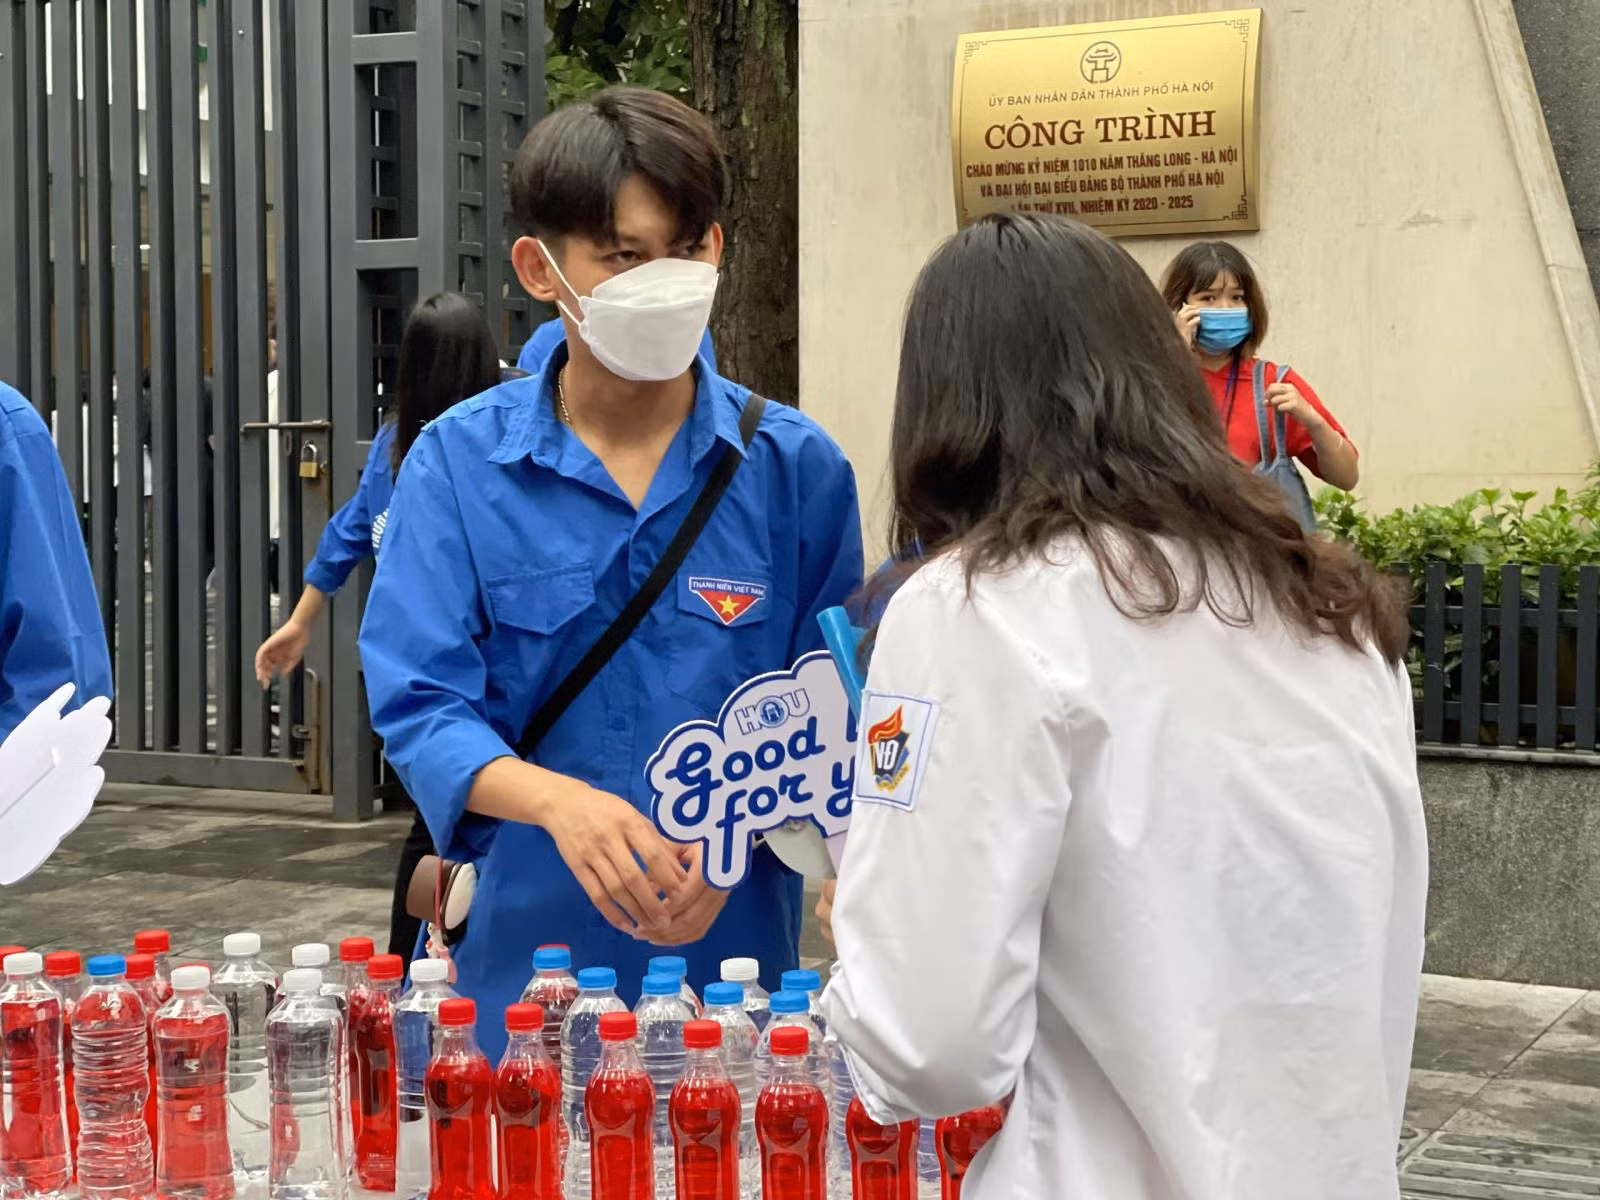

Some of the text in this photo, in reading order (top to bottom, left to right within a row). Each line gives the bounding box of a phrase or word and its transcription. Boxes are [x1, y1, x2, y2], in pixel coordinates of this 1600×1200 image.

[1008, 95, 1031, 106] BAN
[1034, 90, 1067, 103] NHÂN
[1072, 88, 1095, 101] DÂN
[1099, 85, 1139, 99] THÀNH
[1144, 81, 1169, 96] PHỐ
[1172, 81, 1189, 94] HÀ
[1193, 80, 1214, 93] NỘI
[984, 106, 1217, 150] CÔNG TRÌNH
[966, 161, 992, 178] CHÀO
[996, 160, 1025, 176] MỪNG
[1044, 157, 1070, 176] NIỆM
[1073, 158, 1097, 172] 1010
[1100, 154, 1124, 170] NĂM
[1126, 152, 1160, 168] THĂNG
[1164, 152, 1191, 166] LONG
[1202, 147, 1216, 164] HÀ
[1219, 145, 1237, 166] NỘI
[980, 180, 993, 197] VÀ
[996, 183, 1012, 199] ĐẠI
[1015, 180, 1031, 198] HỘI
[1034, 181, 1051, 197] ĐẠI
[1110, 175, 1124, 194] BỘ
[1127, 173, 1161, 191] THÀNH
[1164, 169, 1185, 188] PHỐ
[1188, 170, 1202, 186] HÀ
[1206, 168, 1224, 188] NỘI
[1081, 197, 1114, 215] NHIỆM
[1132, 197, 1158, 211] 2020
[1168, 195, 1194, 209] 2025
[692, 581, 715, 589] THANH
[750, 586, 764, 595] NAM
[734, 688, 811, 736] HOU
[715, 772, 814, 874] for
